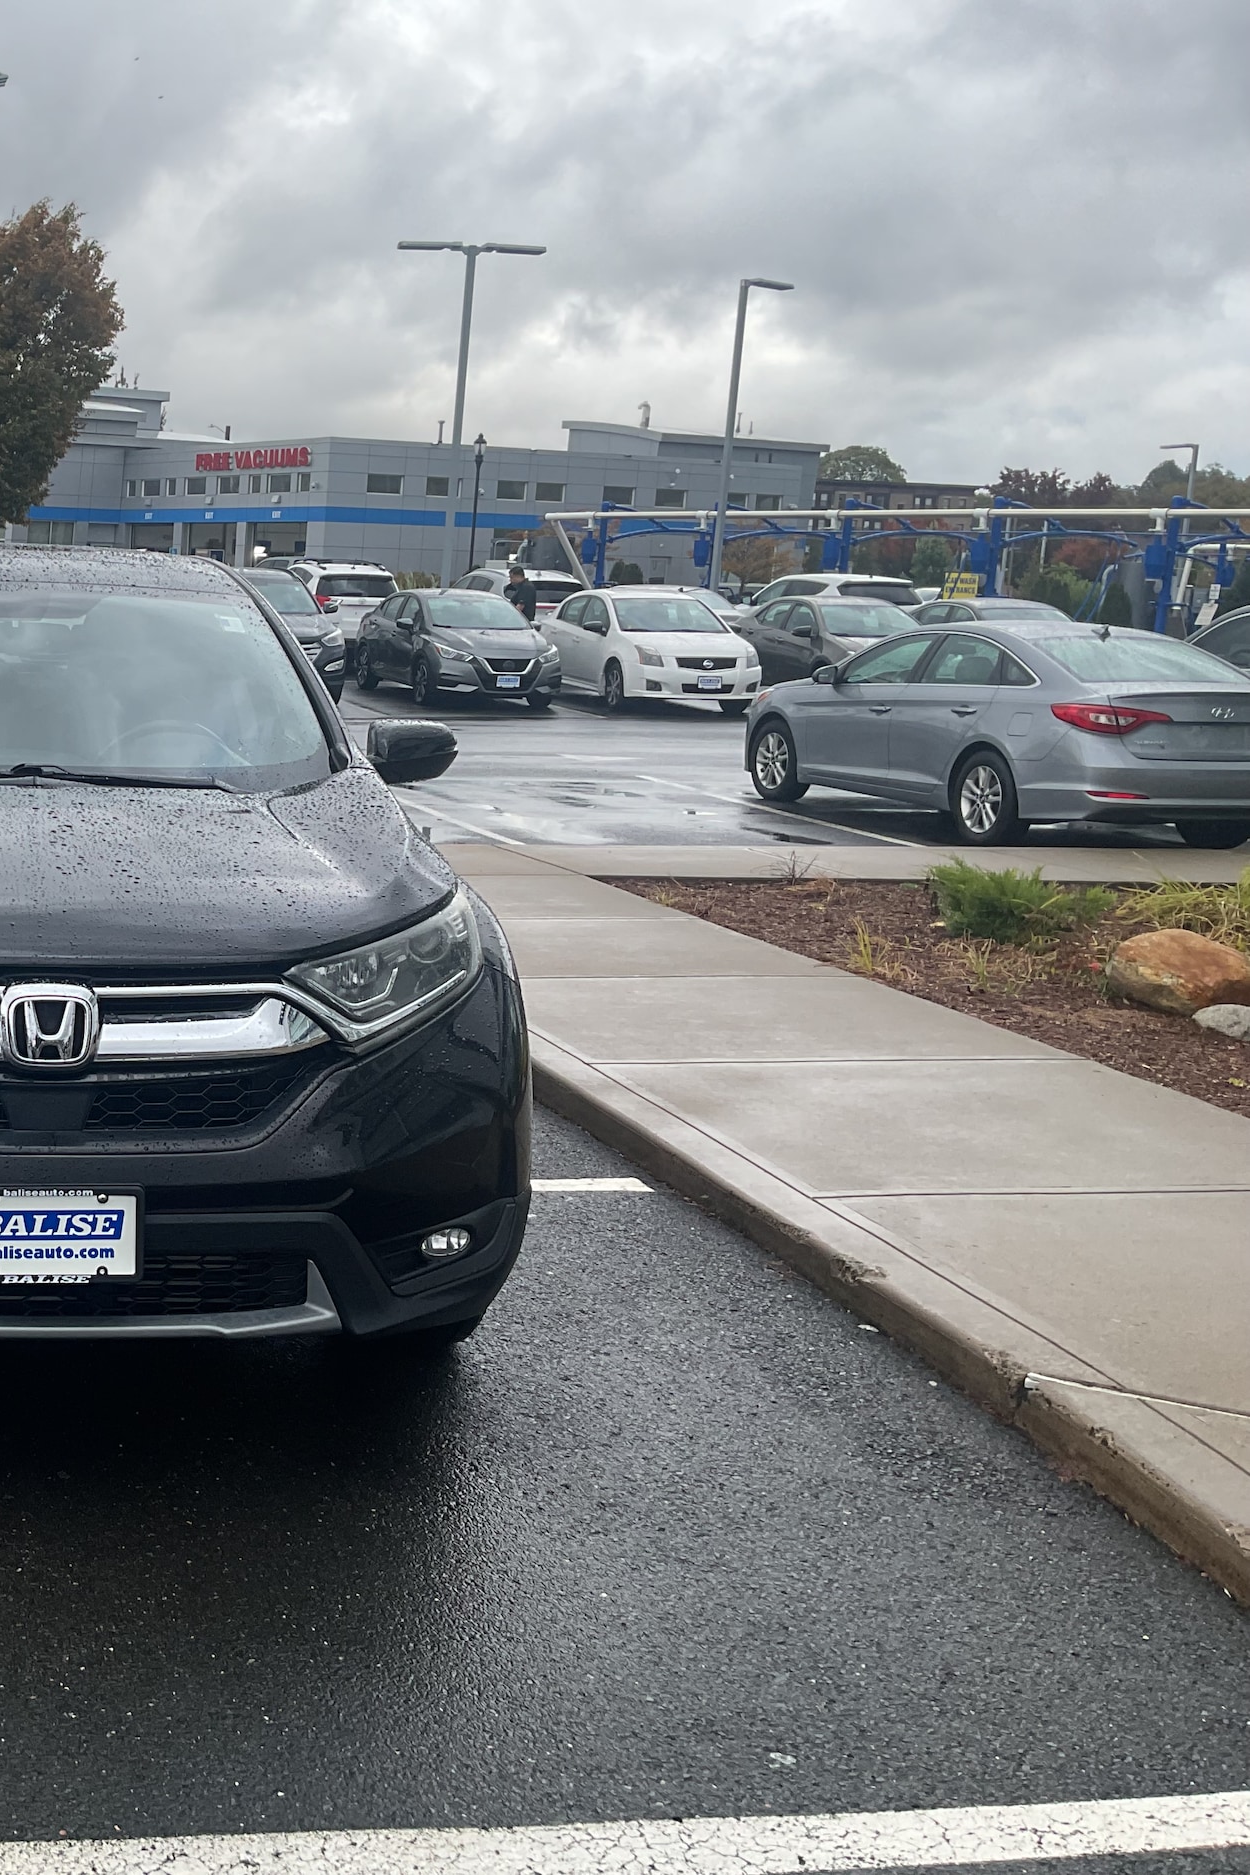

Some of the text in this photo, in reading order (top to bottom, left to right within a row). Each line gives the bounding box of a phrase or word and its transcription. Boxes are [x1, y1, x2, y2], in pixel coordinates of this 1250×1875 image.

[196, 447, 311, 471] FREE VACUUMS
[945, 586, 976, 594] ENRANCE
[3, 1189, 94, 1197] baliseauto.com
[1, 1275, 92, 1284] BALISE
